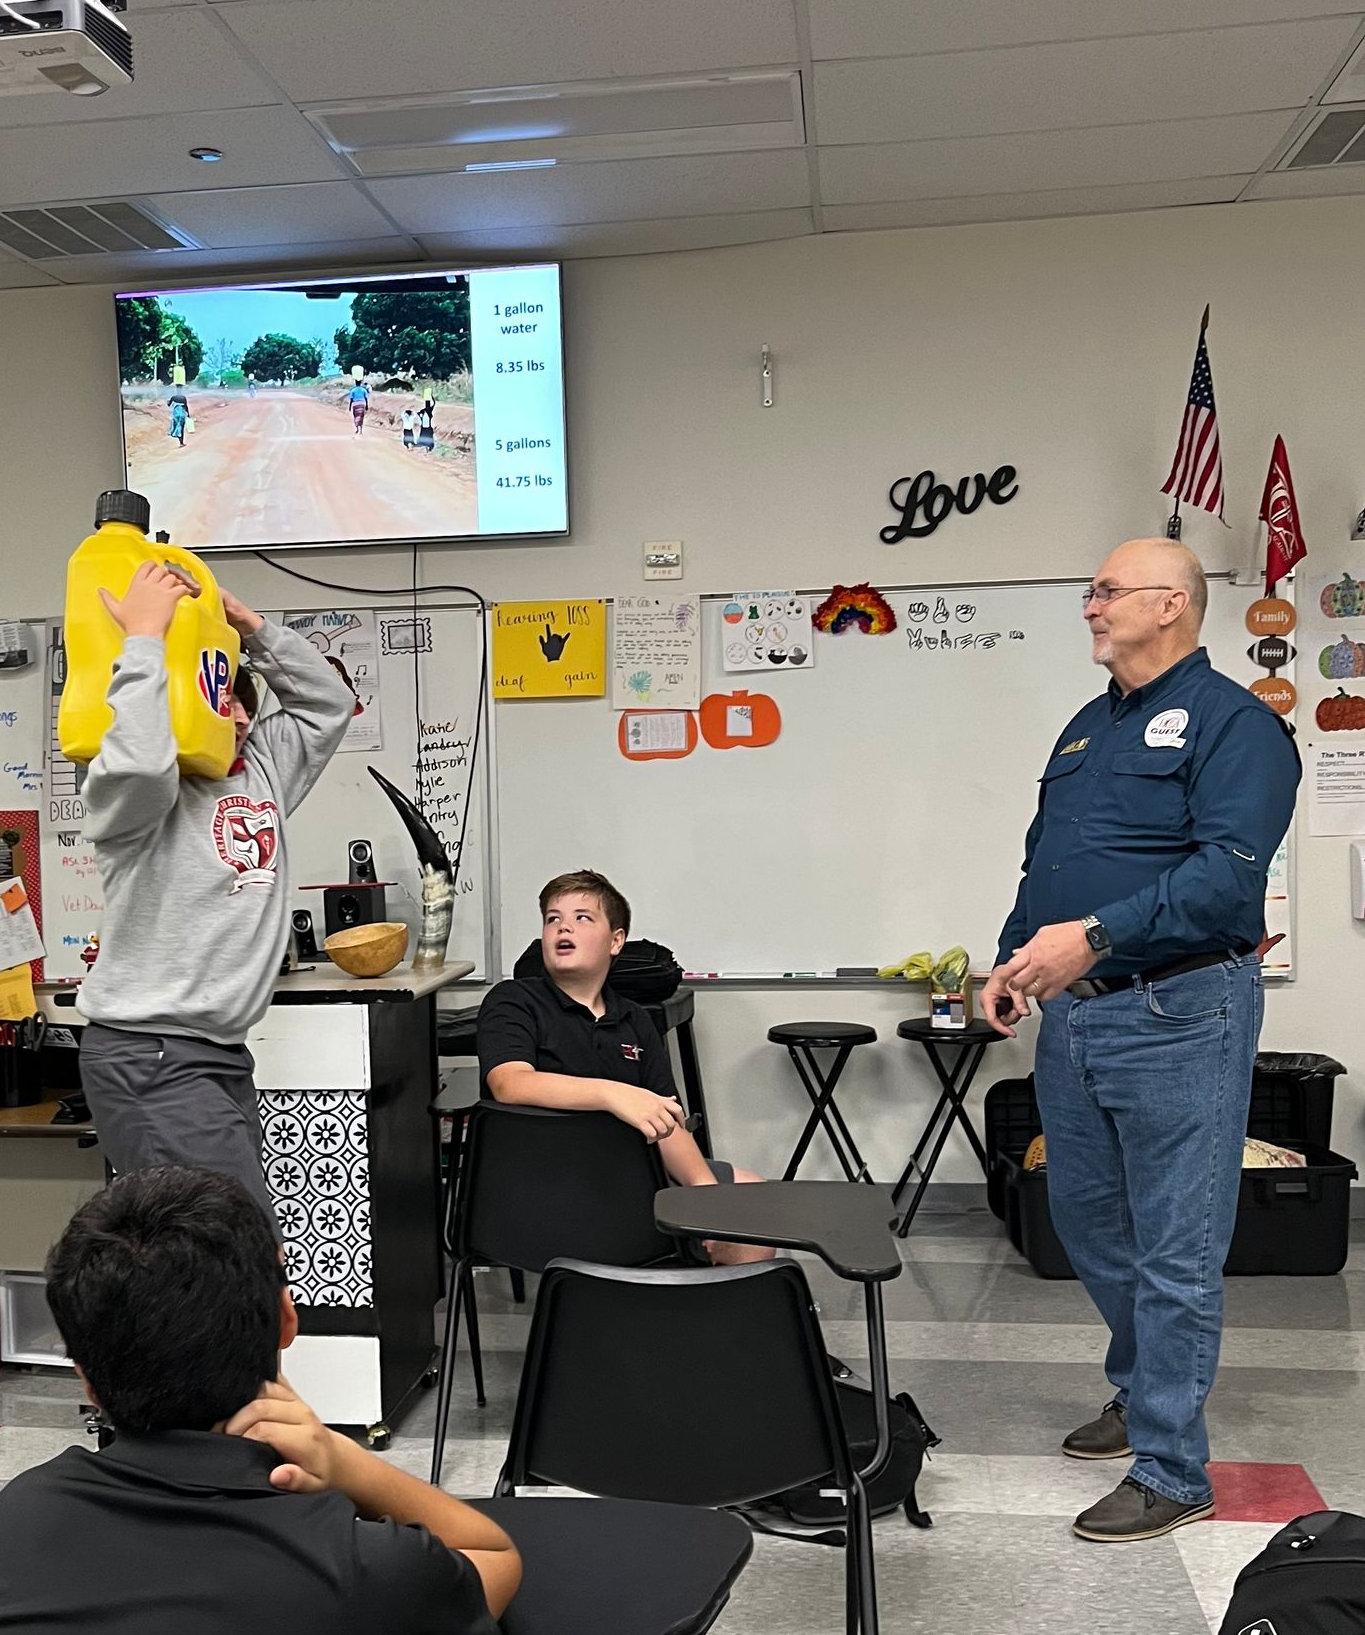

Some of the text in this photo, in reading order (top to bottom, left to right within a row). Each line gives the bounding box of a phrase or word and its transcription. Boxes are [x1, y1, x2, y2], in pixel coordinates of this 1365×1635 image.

[494, 302, 544, 318] 1 gallon
[500, 323, 538, 335] water
[496, 359, 545, 374] 8.35 lbs
[495, 437, 551, 453] 5 gallons
[496, 474, 553, 488] 41.75 lbs
[880, 465, 1019, 544] Love
[1253, 611, 1291, 625] Family
[201, 648, 230, 714] VP
[564, 671, 598, 690] gain
[1151, 727, 1180, 735] GUEST
[3, 762, 28, 773] Good
[50, 799, 87, 822] DEA
